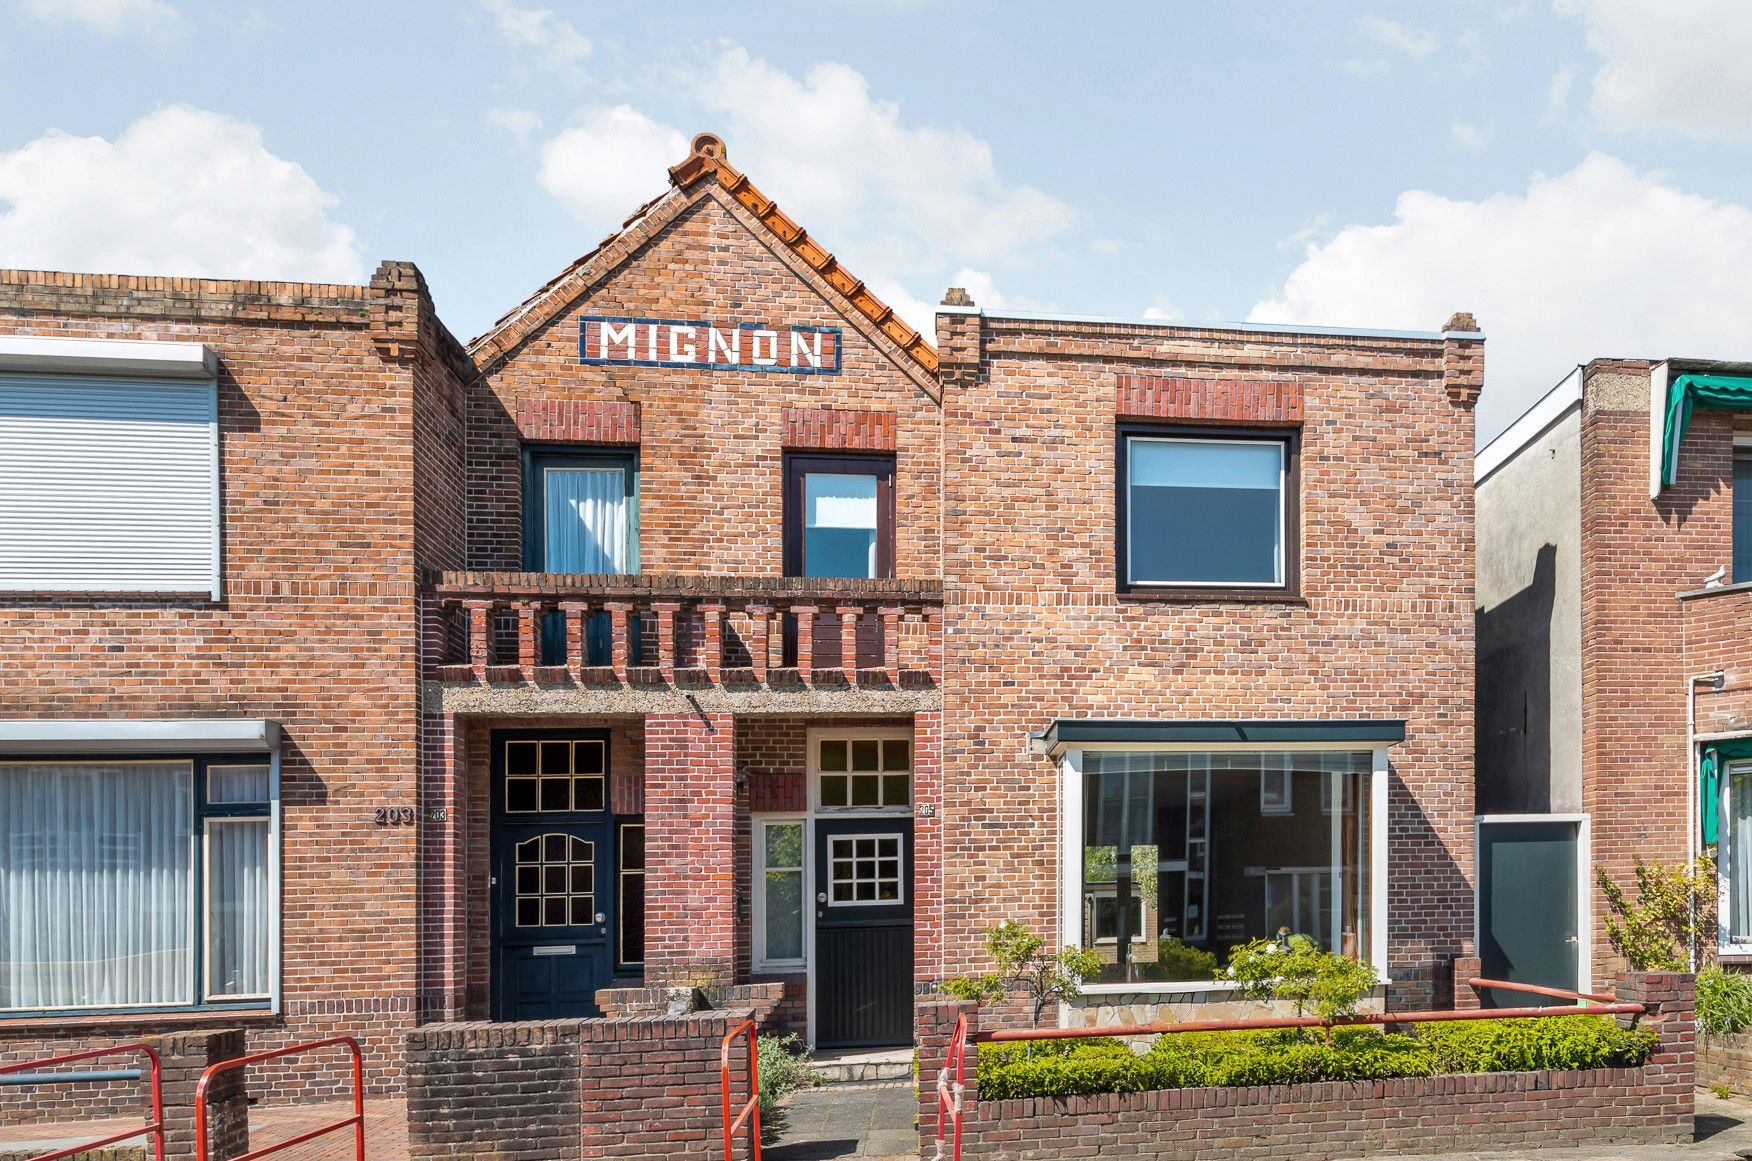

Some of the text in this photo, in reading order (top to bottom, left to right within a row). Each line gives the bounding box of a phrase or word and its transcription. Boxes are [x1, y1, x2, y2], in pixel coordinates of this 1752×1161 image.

[600, 322, 821, 368] MIGNON
[375, 807, 414, 824] 203
[920, 805, 934, 815] 205
